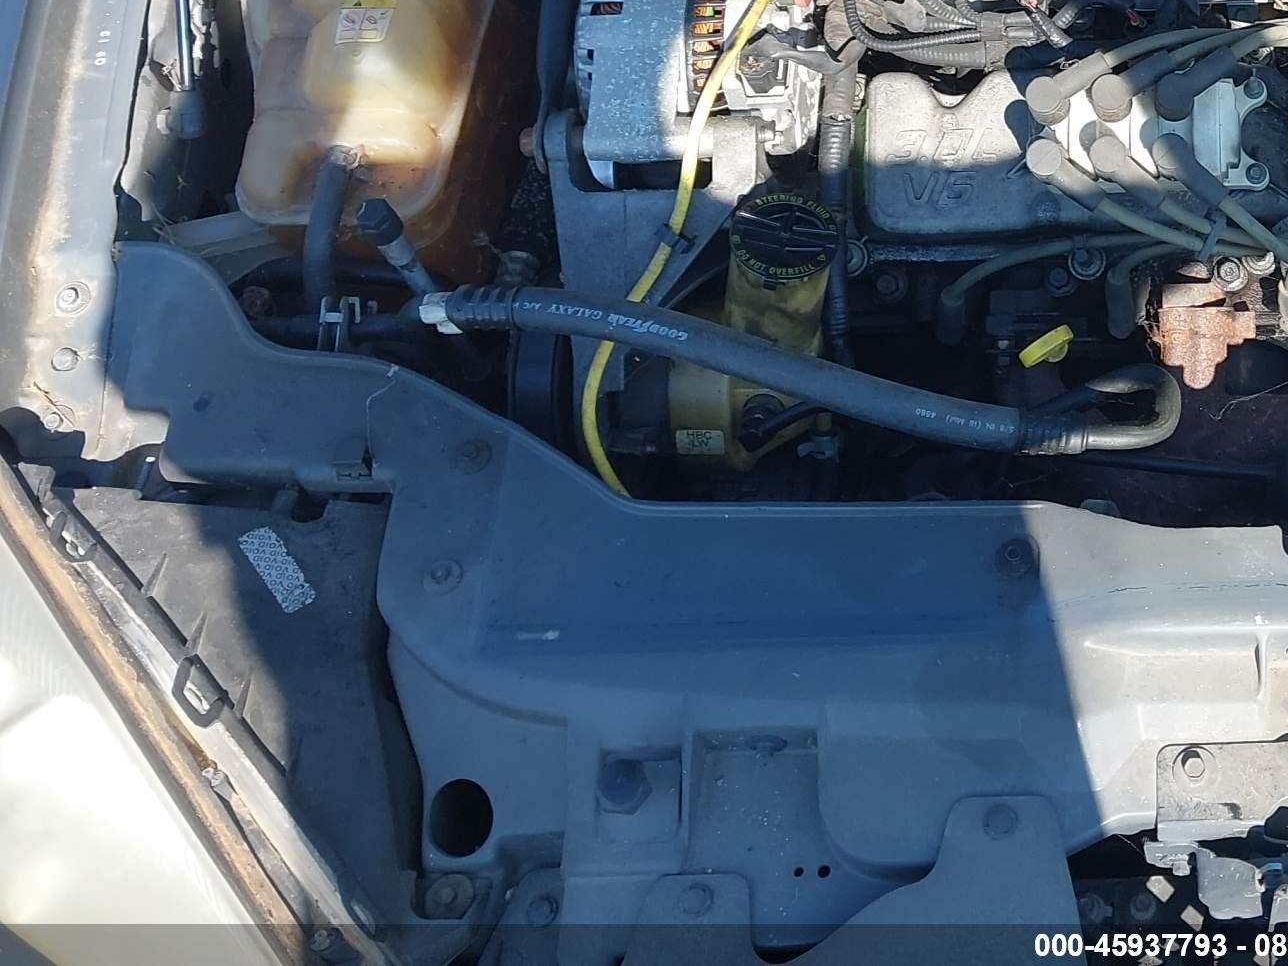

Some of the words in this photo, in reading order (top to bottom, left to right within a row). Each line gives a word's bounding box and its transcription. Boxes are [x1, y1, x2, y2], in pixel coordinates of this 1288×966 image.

[903, 170, 978, 210] V6
[768, 263, 816, 275] OVERFILL
[547, 303, 603, 321] GALAXY
